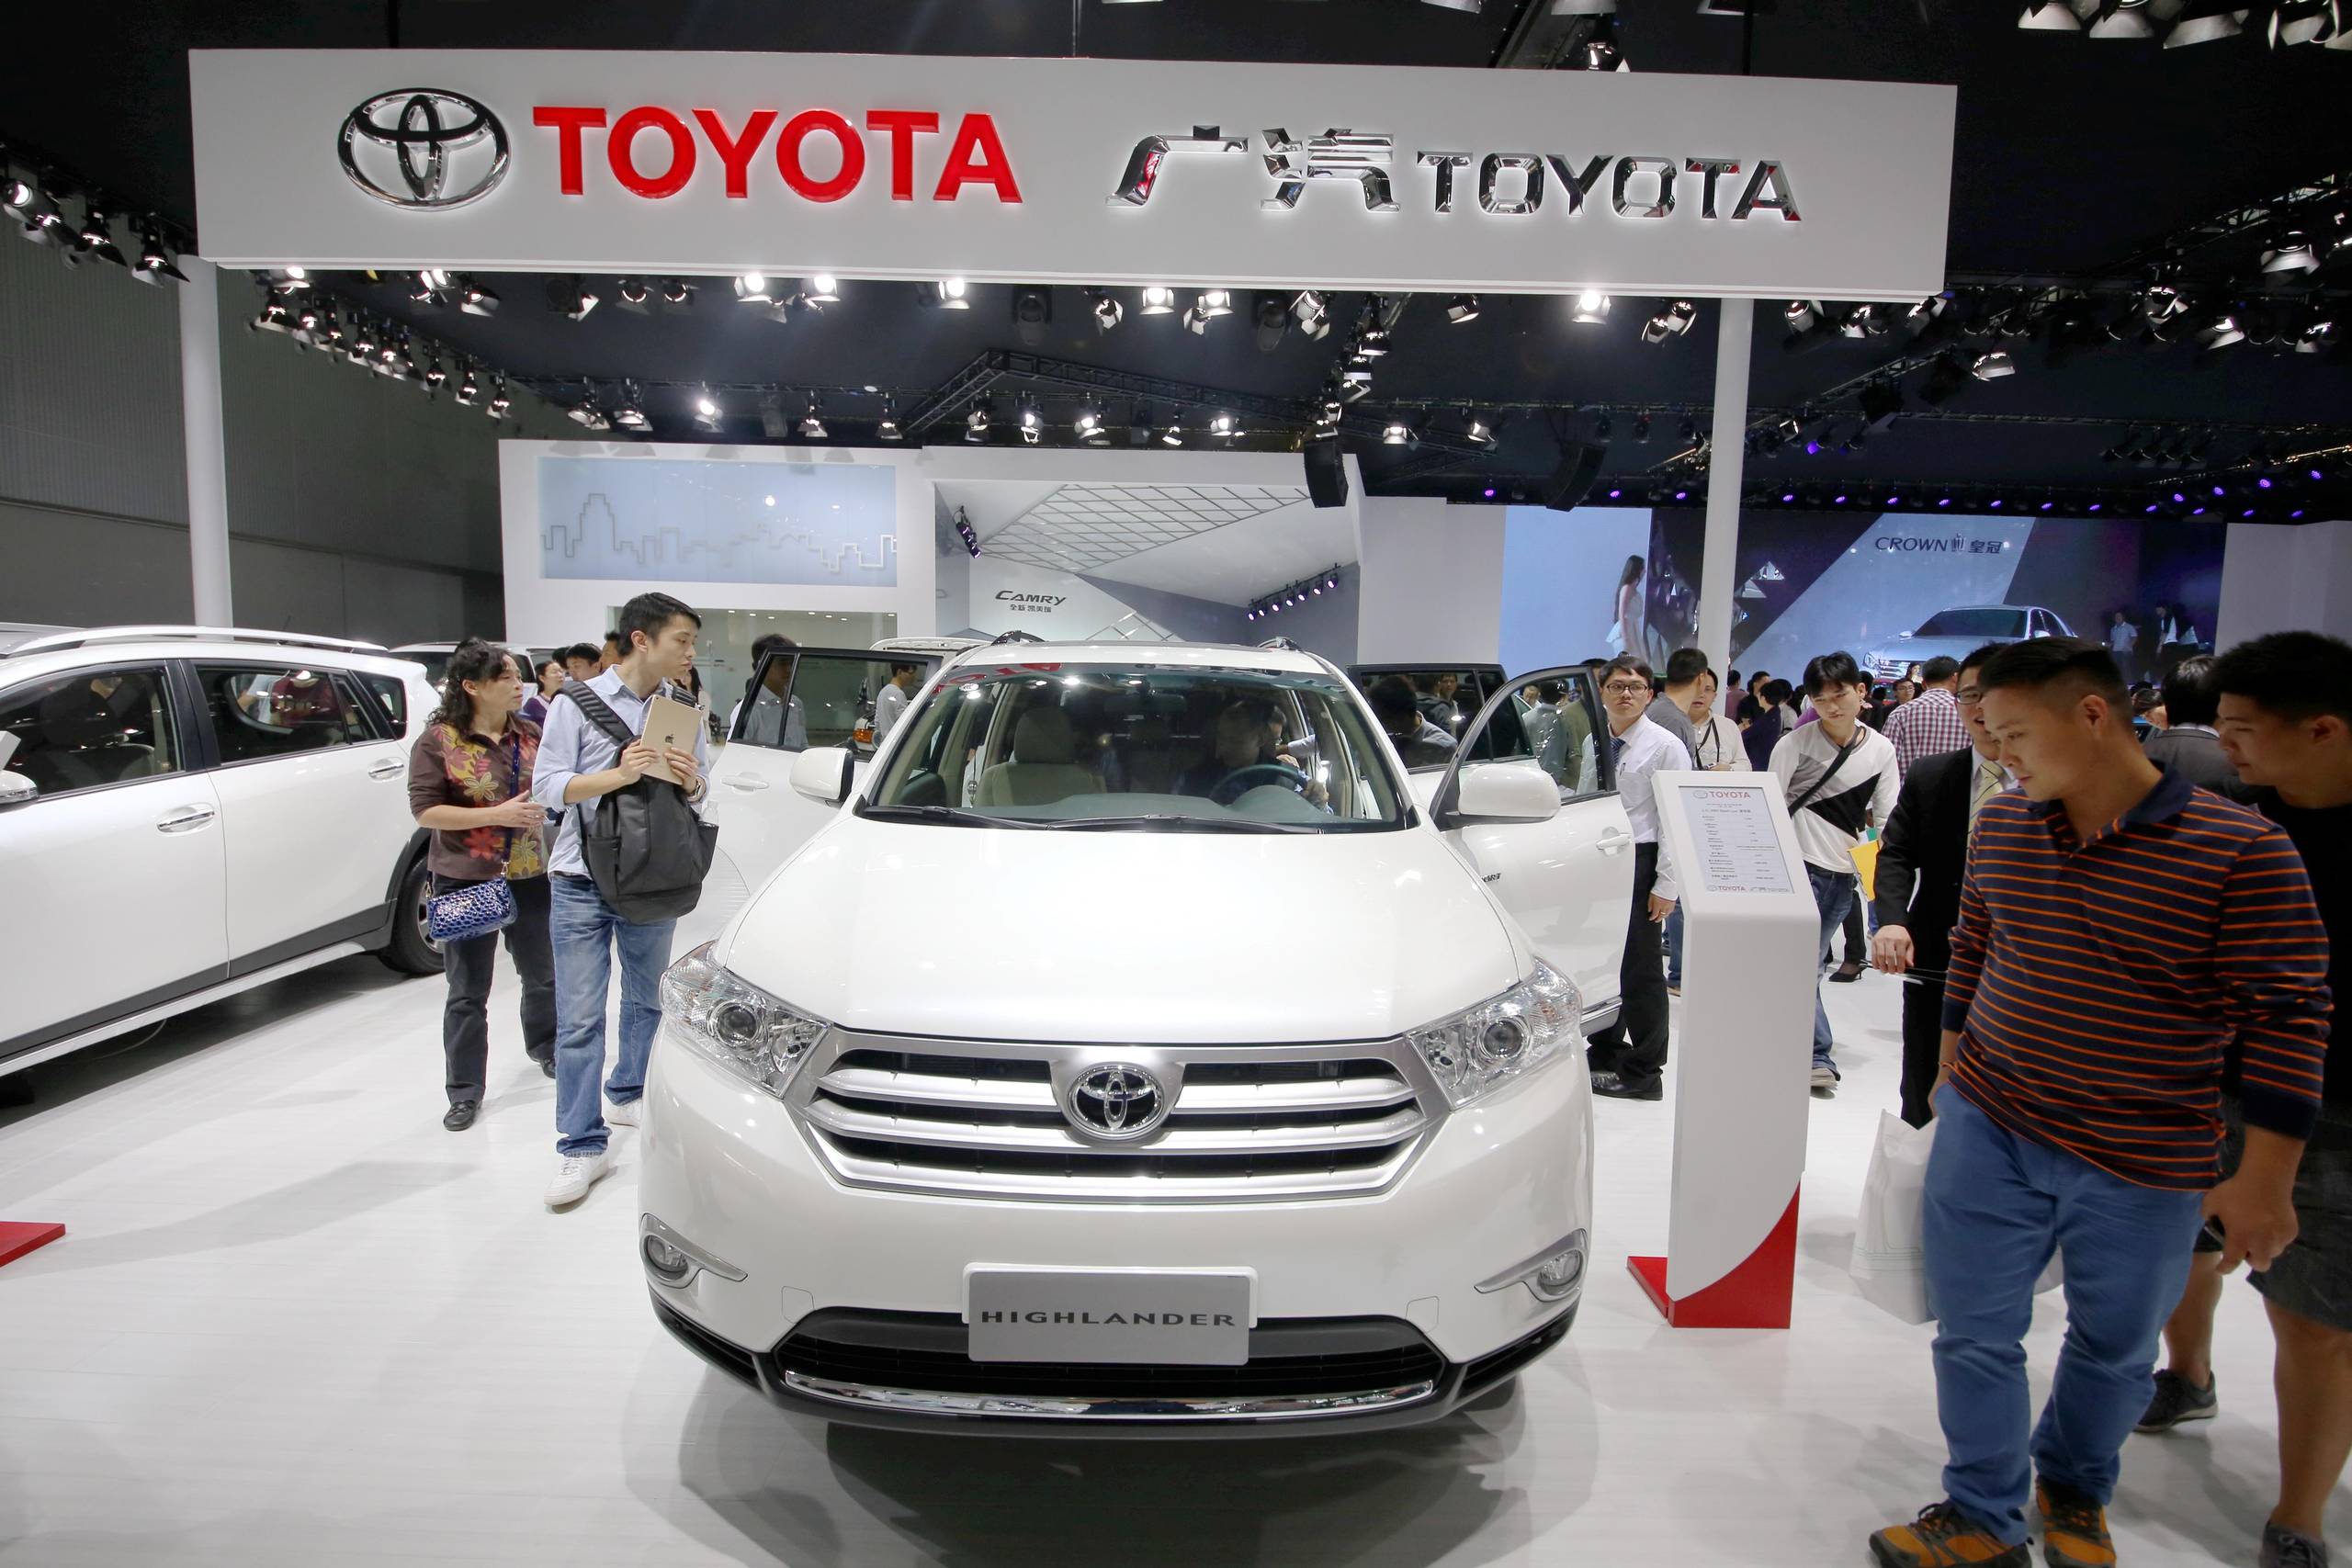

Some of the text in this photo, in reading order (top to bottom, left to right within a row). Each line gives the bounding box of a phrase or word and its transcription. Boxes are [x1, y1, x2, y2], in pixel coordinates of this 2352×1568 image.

[533, 106, 1023, 204] TOYOTA
[1104, 125, 1803, 222] 广汽 TOYOTA
[1875, 536, 2003, 554] CROWN 皇冠
[995, 591, 1066, 605] CAMRY
[980, 1311, 1236, 1326] HIGHLANDER
